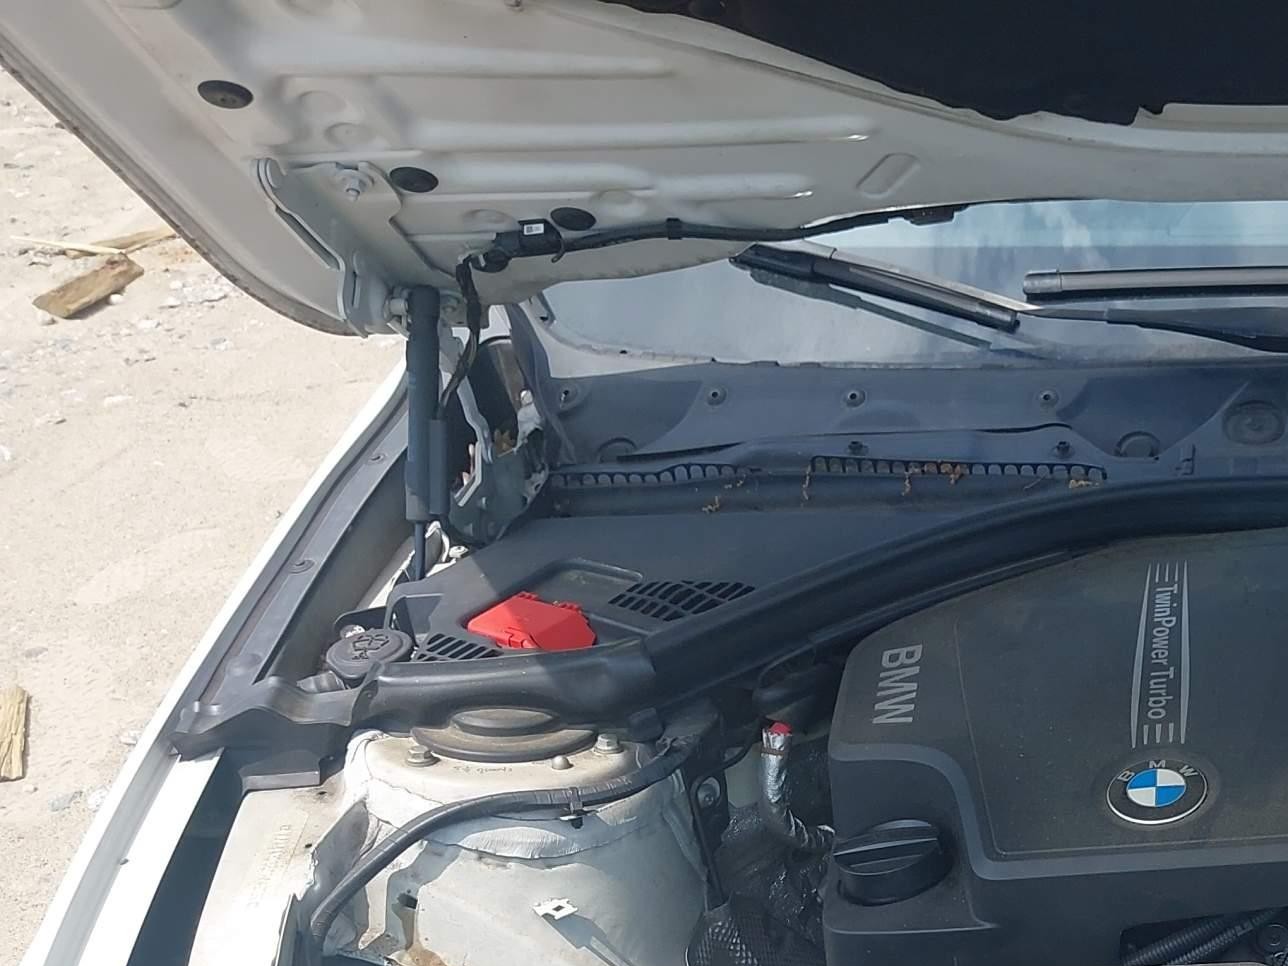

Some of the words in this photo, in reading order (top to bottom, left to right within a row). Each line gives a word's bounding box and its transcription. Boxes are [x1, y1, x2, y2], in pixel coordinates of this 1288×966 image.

[1151, 583, 1178, 665] TwinPower
[872, 644, 922, 724] BMW
[1148, 666, 1174, 719] Turbo
[1117, 759, 1198, 781] BMW
